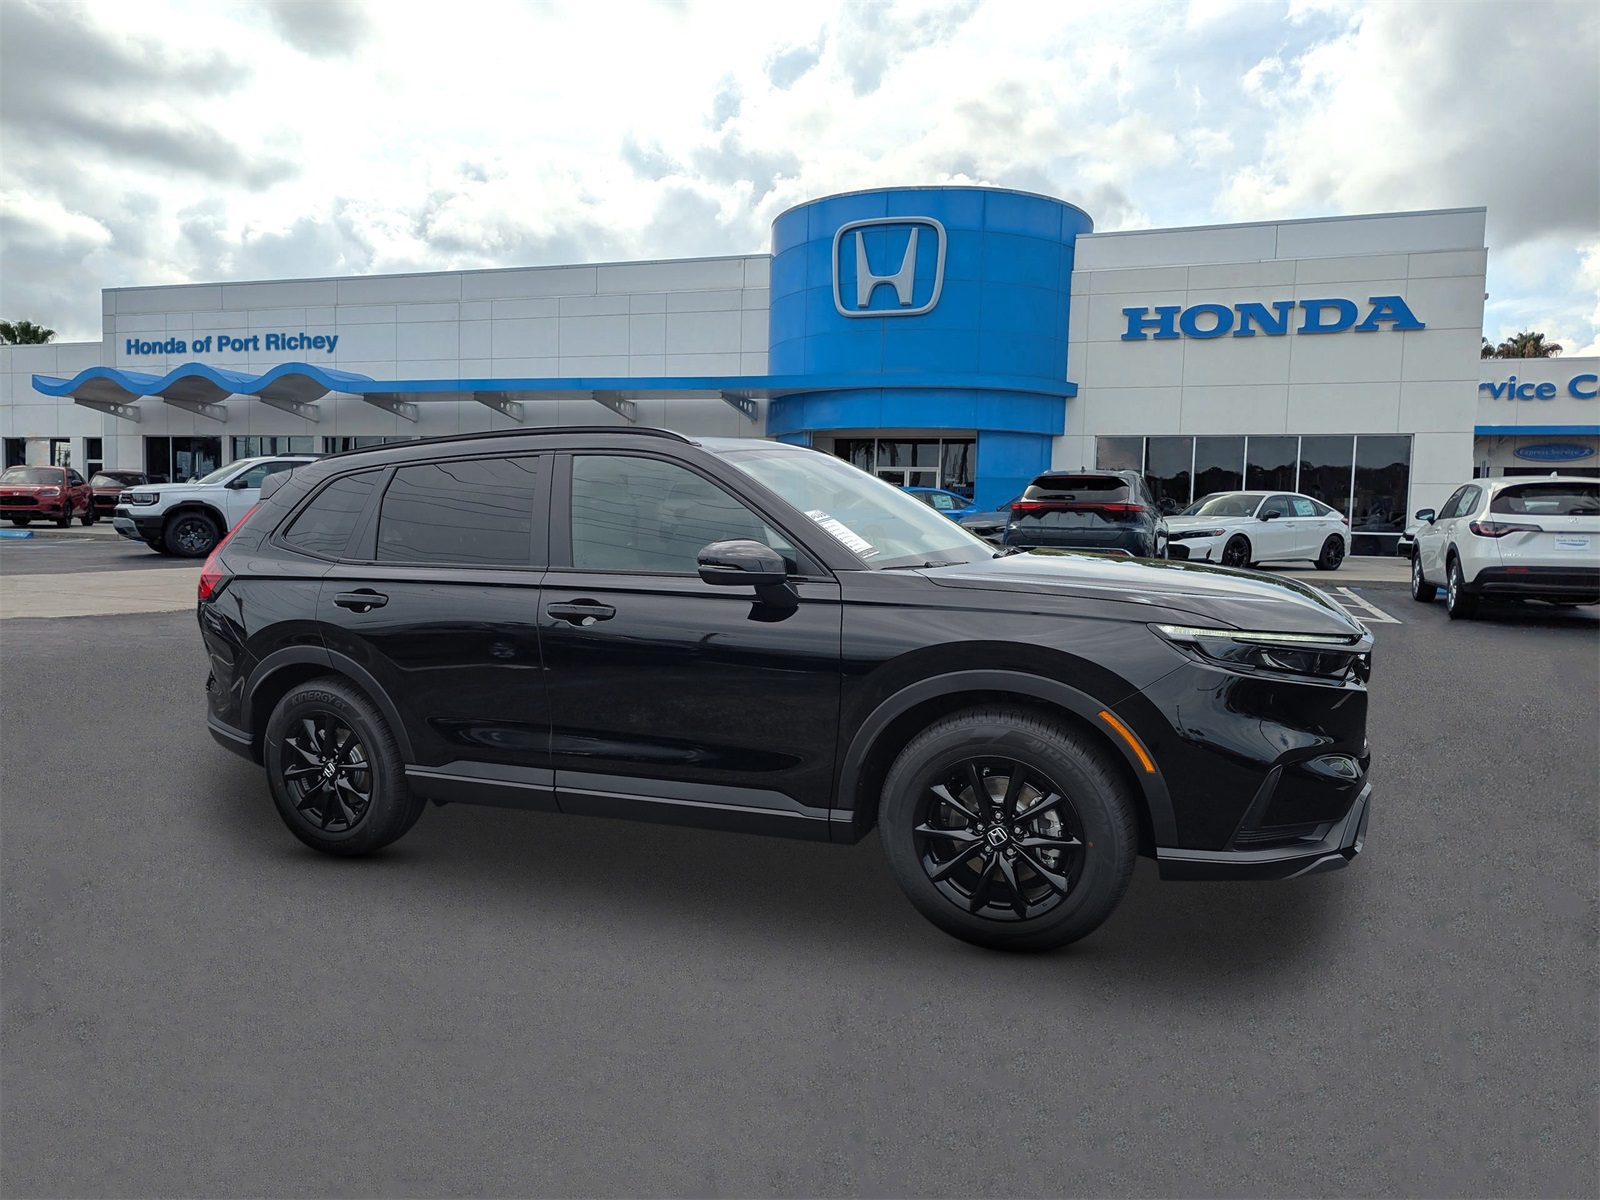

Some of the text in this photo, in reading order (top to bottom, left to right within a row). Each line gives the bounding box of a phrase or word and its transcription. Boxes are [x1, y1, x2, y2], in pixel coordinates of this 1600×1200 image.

[1120, 295, 1426, 341] HONDA
[126, 333, 339, 355] Honda of Port Richey
